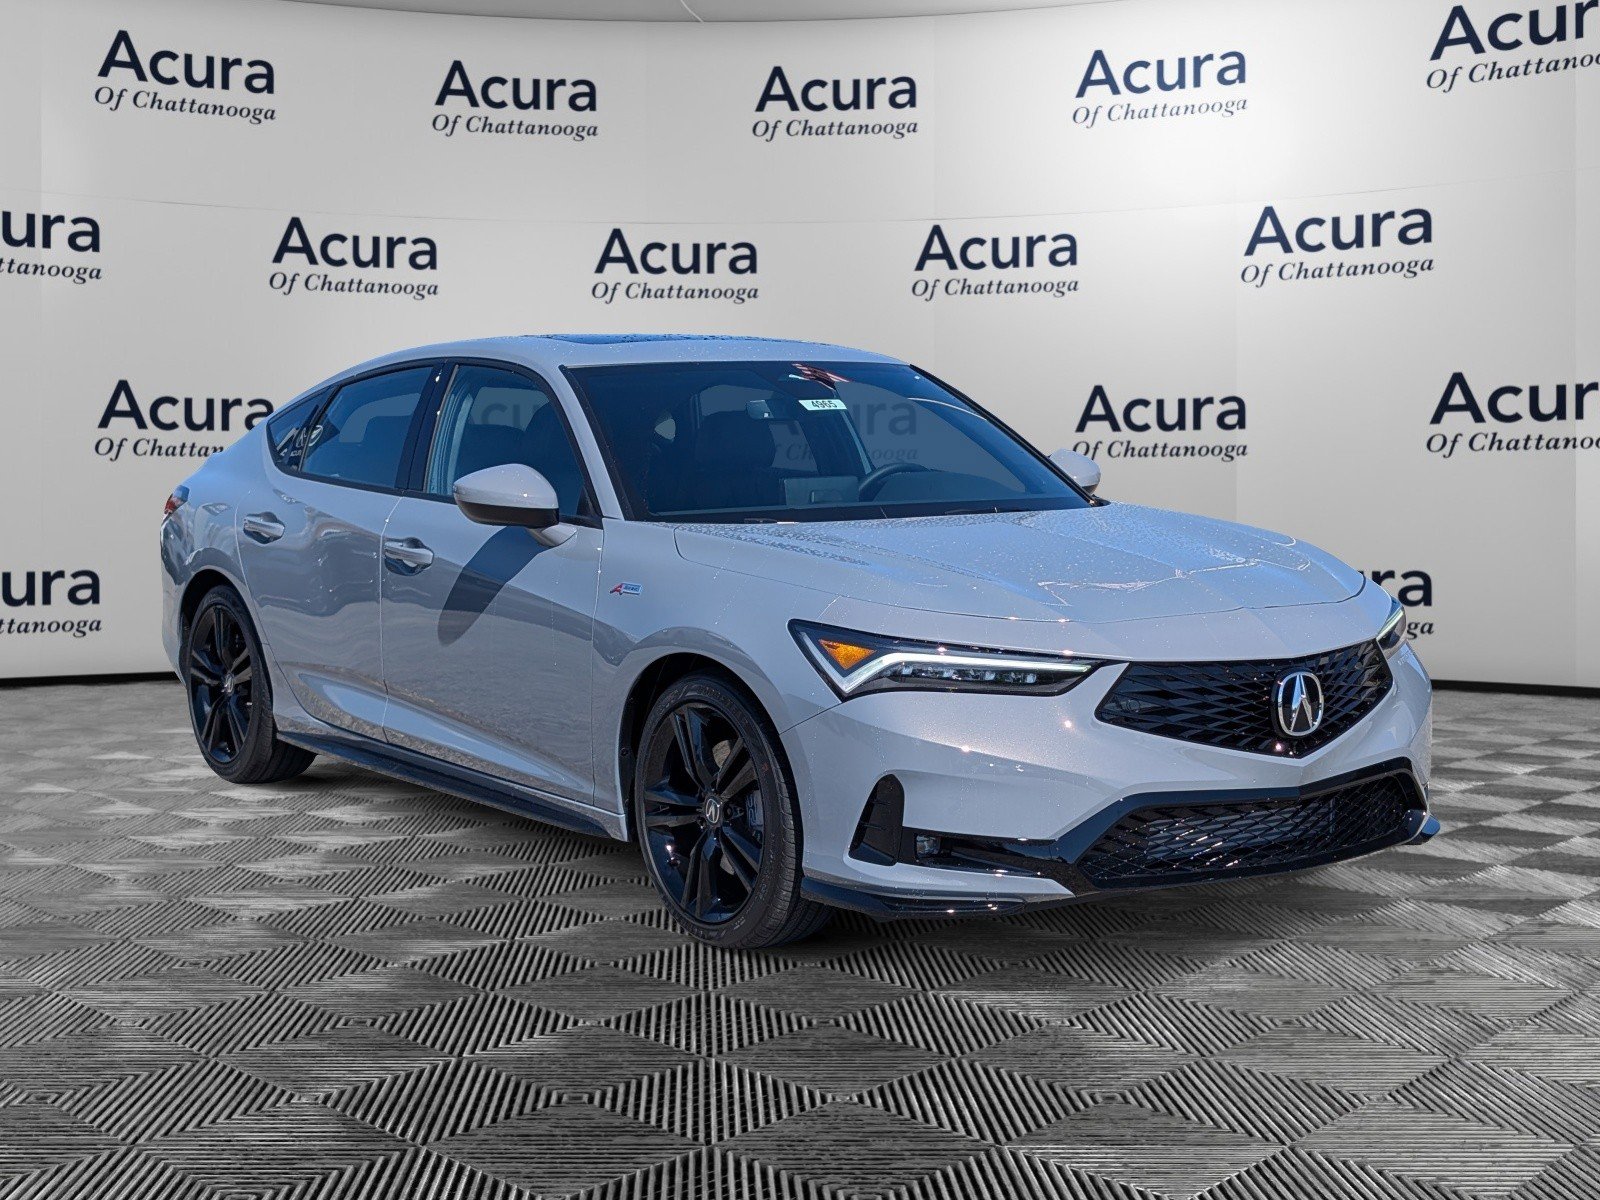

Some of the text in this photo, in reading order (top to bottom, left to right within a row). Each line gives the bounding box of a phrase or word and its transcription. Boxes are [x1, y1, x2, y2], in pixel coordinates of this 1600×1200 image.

[1428, 0, 1600, 62] Acur
[96, 29, 275, 95] Acura
[1074, 49, 1247, 99] Acura
[1425, 52, 1600, 93] Of Chattano
[94, 85, 277, 126] Of Chattanooga
[434, 59, 598, 113] Acura
[754, 65, 918, 113] Acura
[431, 113, 599, 142] Of Chattanooga
[751, 118, 918, 143] Of Chattanooga
[1071, 99, 1248, 128] Of Chattanooga
[0, 209, 101, 254] ura
[271, 215, 438, 271] Acura
[593, 227, 758, 276] Acura
[913, 223, 1078, 272] Acura
[1243, 205, 1433, 257] Acura
[0, 257, 103, 286] ttanooga
[268, 271, 439, 301] Of Chattanooga
[911, 277, 1079, 303] Of Chattanooga
[1240, 258, 1435, 288] Of Chattanooga
[591, 281, 759, 305] Of Chattanooga
[97, 378, 275, 432] Acura
[1074, 384, 1247, 434] Acura
[1429, 371, 1600, 426] Acur
[94, 436, 129, 463] Of
[1072, 440, 1248, 463] Of Chattanooga
[1425, 431, 1600, 459] Of Chattano
[0, 569, 101, 608] ura
[0, 618, 102, 639] ttanooga
